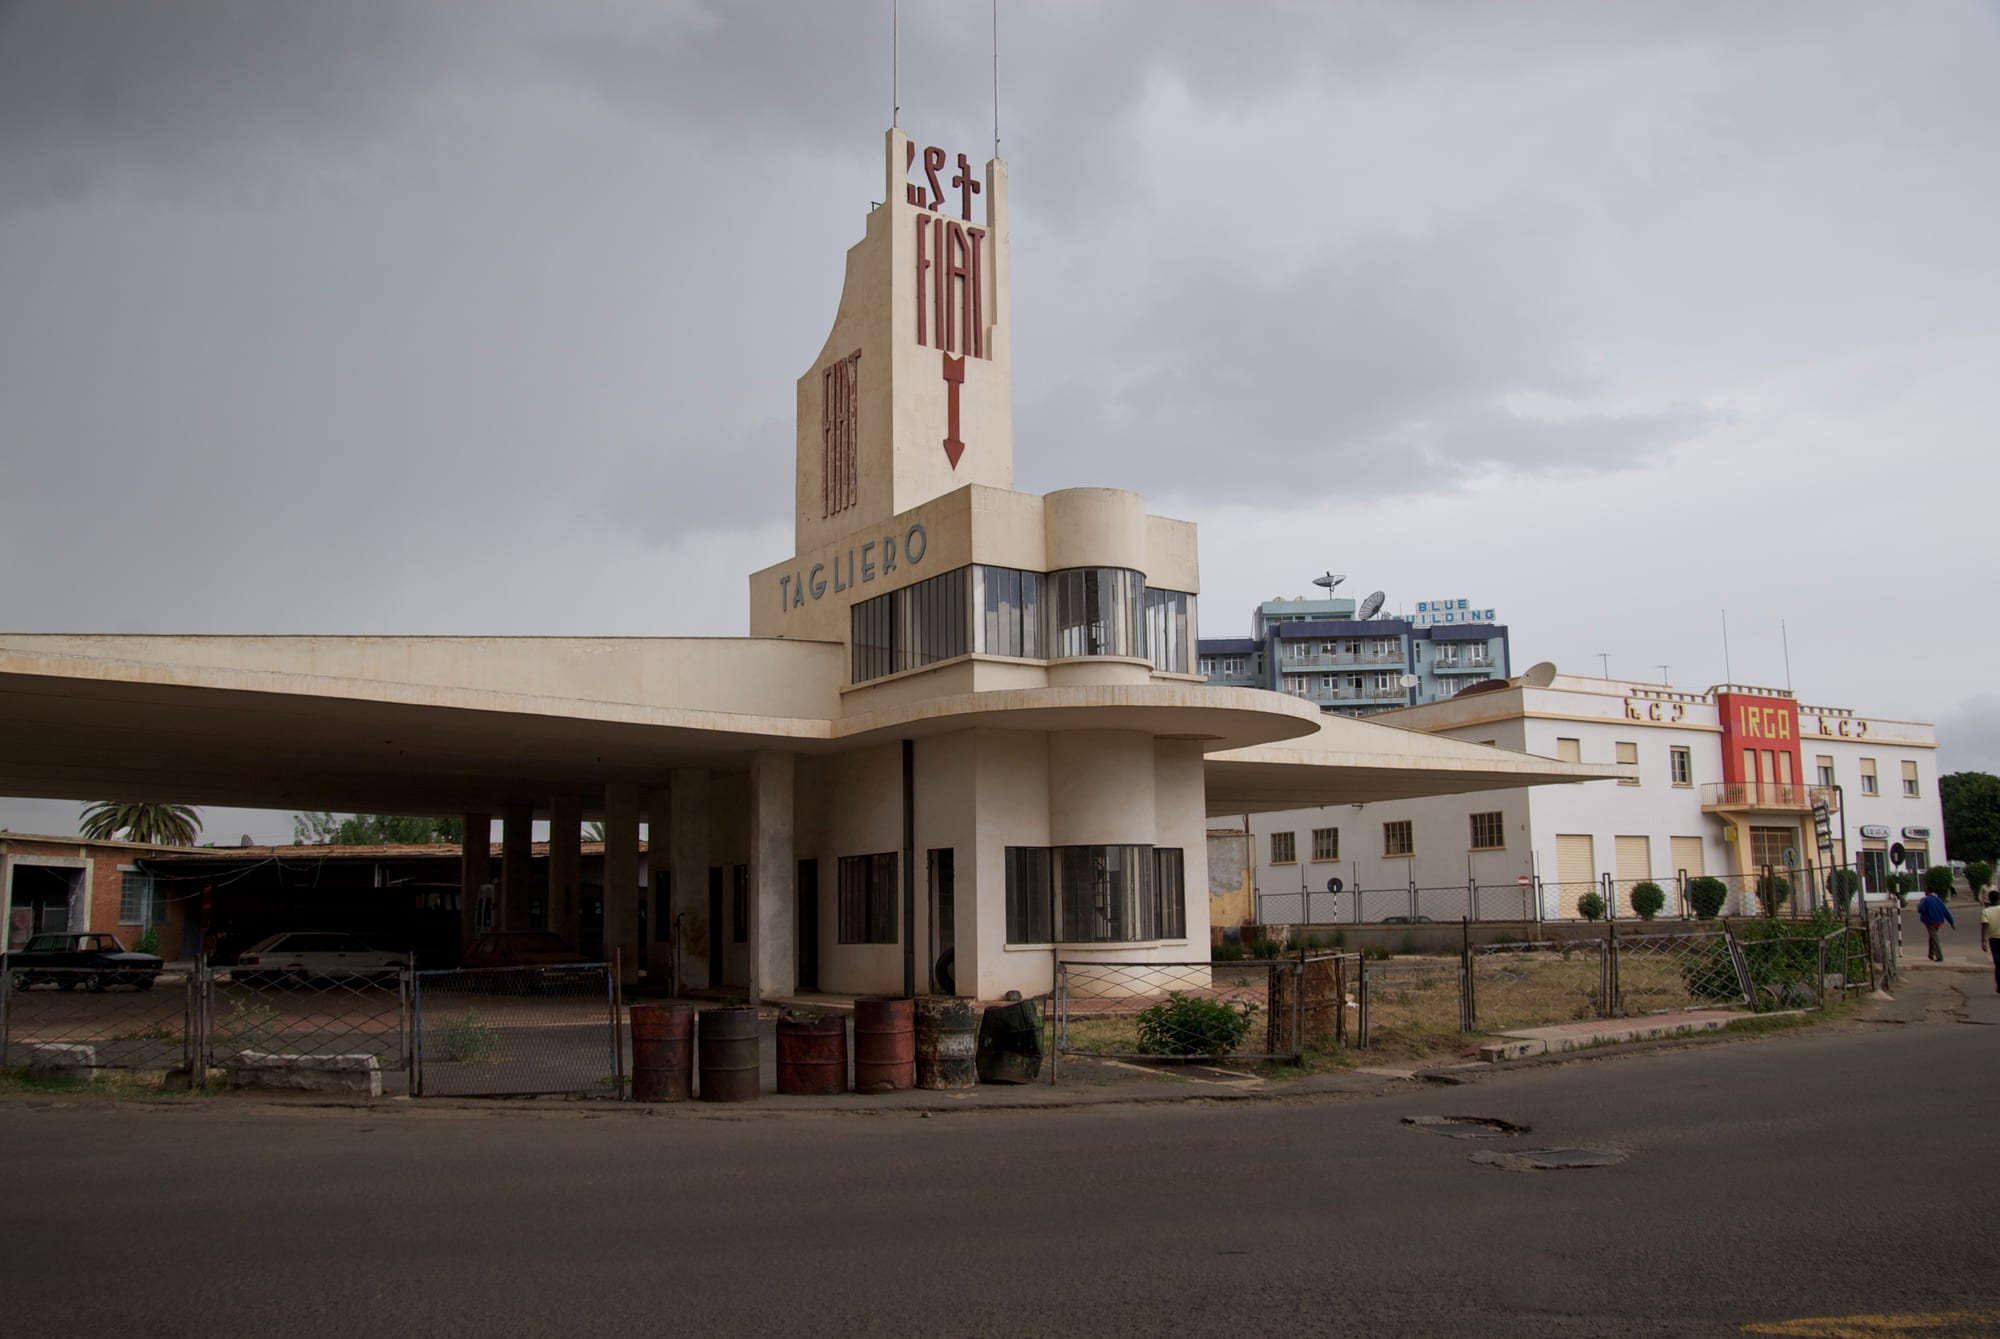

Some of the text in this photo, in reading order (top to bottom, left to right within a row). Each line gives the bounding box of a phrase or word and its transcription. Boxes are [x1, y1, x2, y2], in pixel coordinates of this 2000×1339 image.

[916, 212, 986, 360] FIAT
[821, 348, 862, 519] FIAT
[780, 524, 927, 612] TAGLIERO
[1418, 599, 1468, 612] BLUE
[1740, 705, 1791, 740] IRGA
